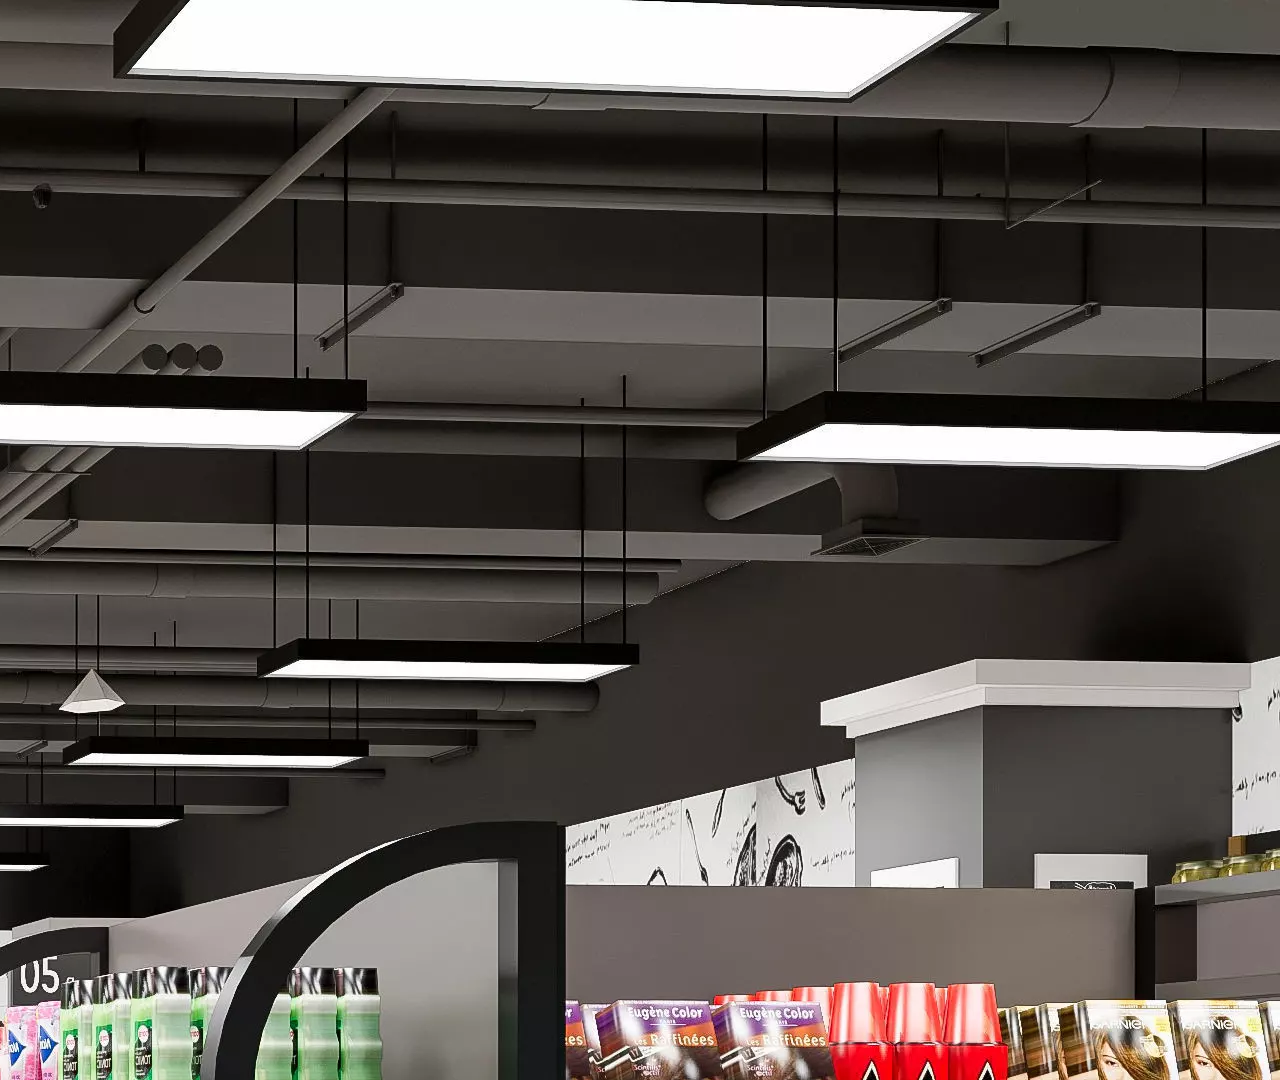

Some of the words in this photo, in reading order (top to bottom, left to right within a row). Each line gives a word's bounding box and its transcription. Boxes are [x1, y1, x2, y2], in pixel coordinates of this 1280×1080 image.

[20, 955, 60, 994] 05
[627, 1007, 670, 1021] Eugène
[671, 1006, 703, 1018] Color
[739, 1008, 782, 1021] Eugène
[784, 1007, 815, 1019] Color
[650, 1033, 714, 1047] Raffinées
[762, 1033, 826, 1047] Raffinées
